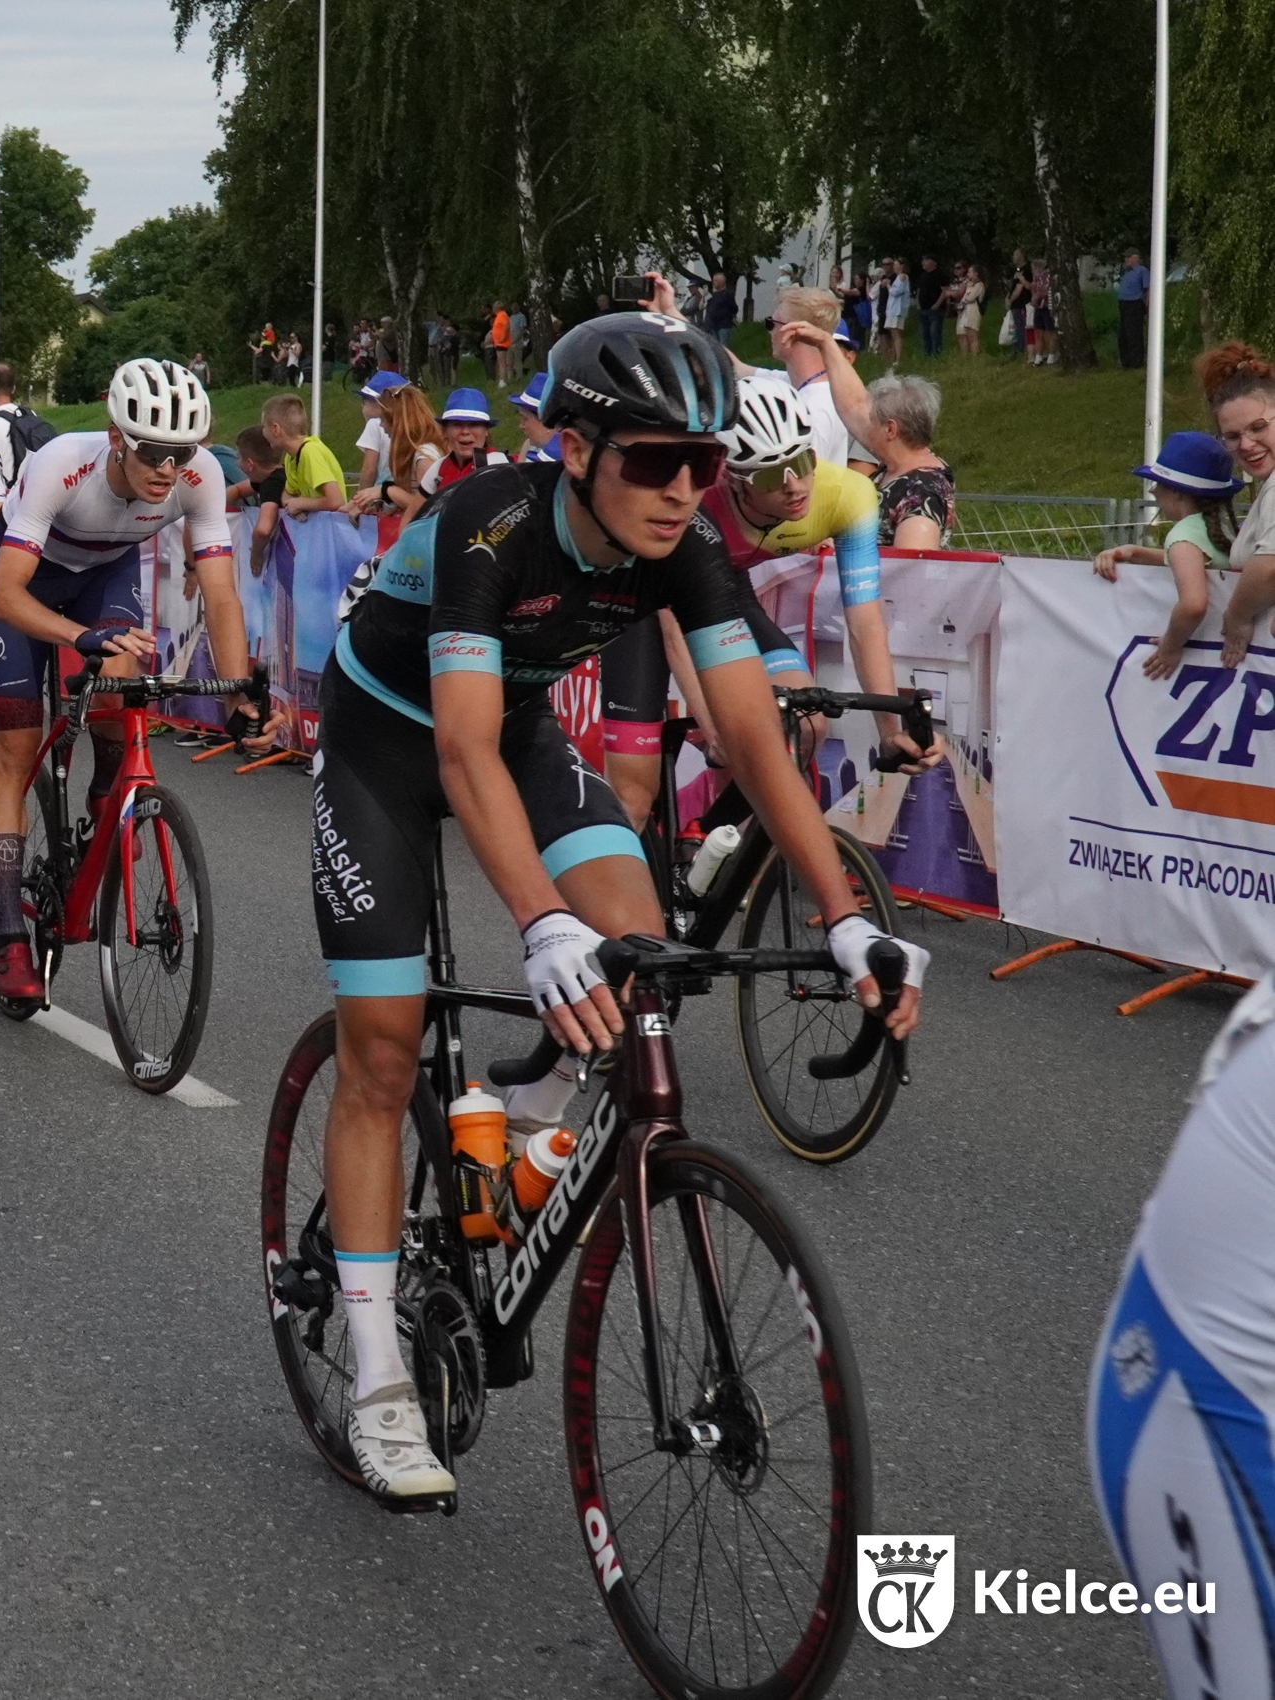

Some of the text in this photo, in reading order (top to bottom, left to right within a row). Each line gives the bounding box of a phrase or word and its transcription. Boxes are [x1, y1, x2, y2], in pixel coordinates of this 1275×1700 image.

[562, 378, 620, 407] SCOTT
[630, 364, 658, 400] youfone
[432, 646, 487, 660] SUMCAR
[313, 781, 376, 913] lubelskie
[1069, 838, 1153, 883] ZWIĄZEK
[494, 1090, 617, 1326] corratec
